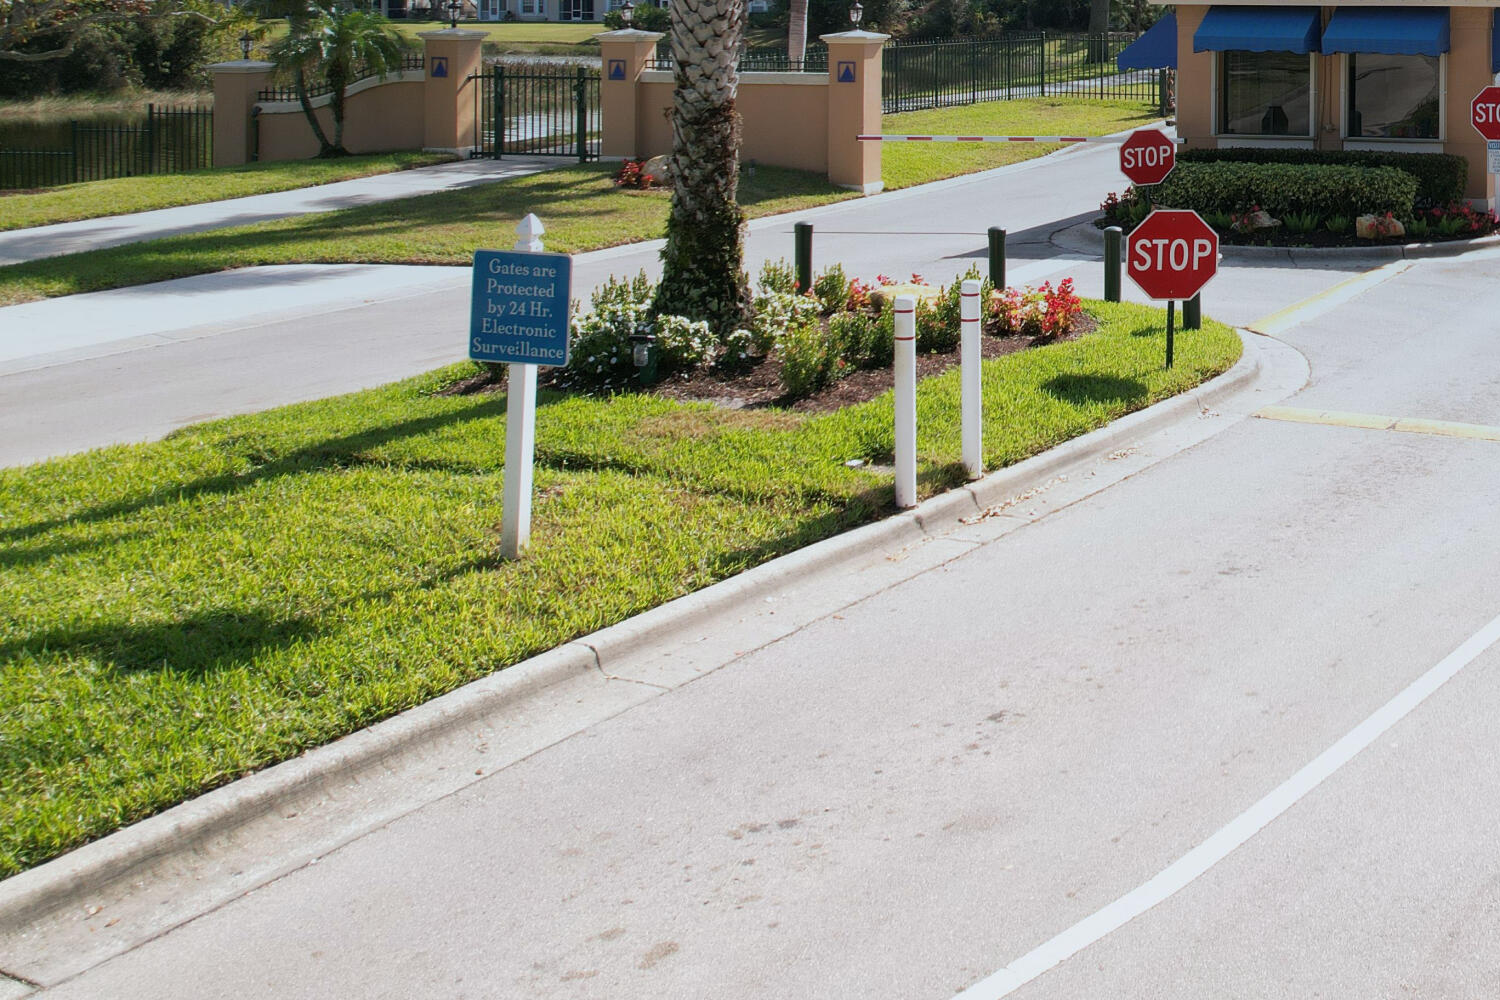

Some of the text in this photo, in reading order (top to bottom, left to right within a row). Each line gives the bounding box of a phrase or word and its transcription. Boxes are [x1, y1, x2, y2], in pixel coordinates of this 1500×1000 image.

[1123, 145, 1171, 169] STOP
[1133, 238, 1212, 271] STOP
[489, 258, 557, 278] Gates are
[487, 278, 555, 298] Protected
[487, 299, 553, 318] by 24 Hr.
[481, 318, 557, 338] Electronic
[472, 337, 564, 359] Surveillance
